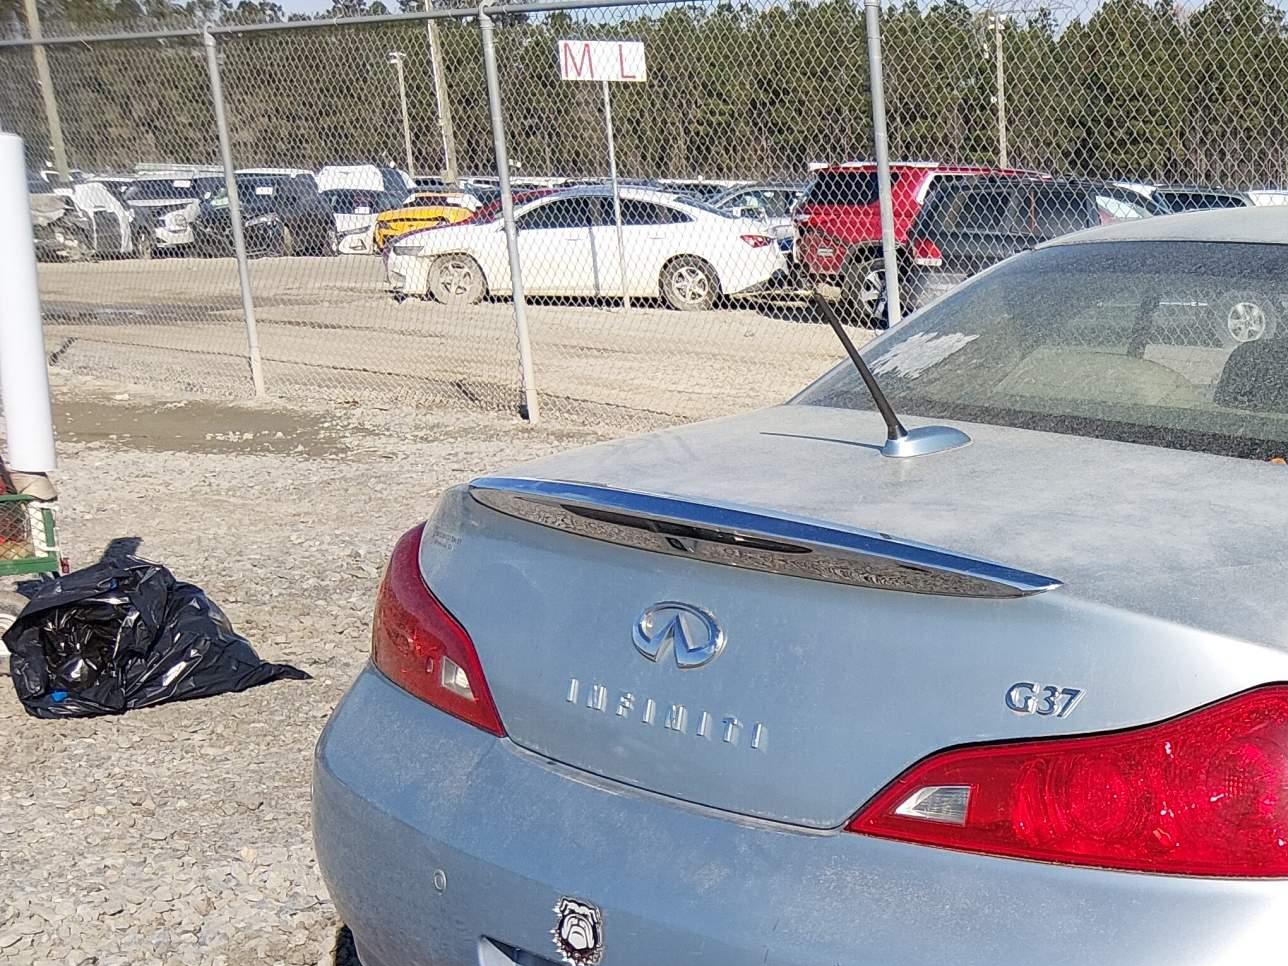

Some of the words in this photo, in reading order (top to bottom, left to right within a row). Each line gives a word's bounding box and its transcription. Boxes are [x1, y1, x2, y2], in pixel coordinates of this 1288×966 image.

[563, 42, 595, 79] M
[618, 43, 637, 79] L
[566, 677, 768, 749] INFINITI
[1004, 681, 1086, 719] G37
